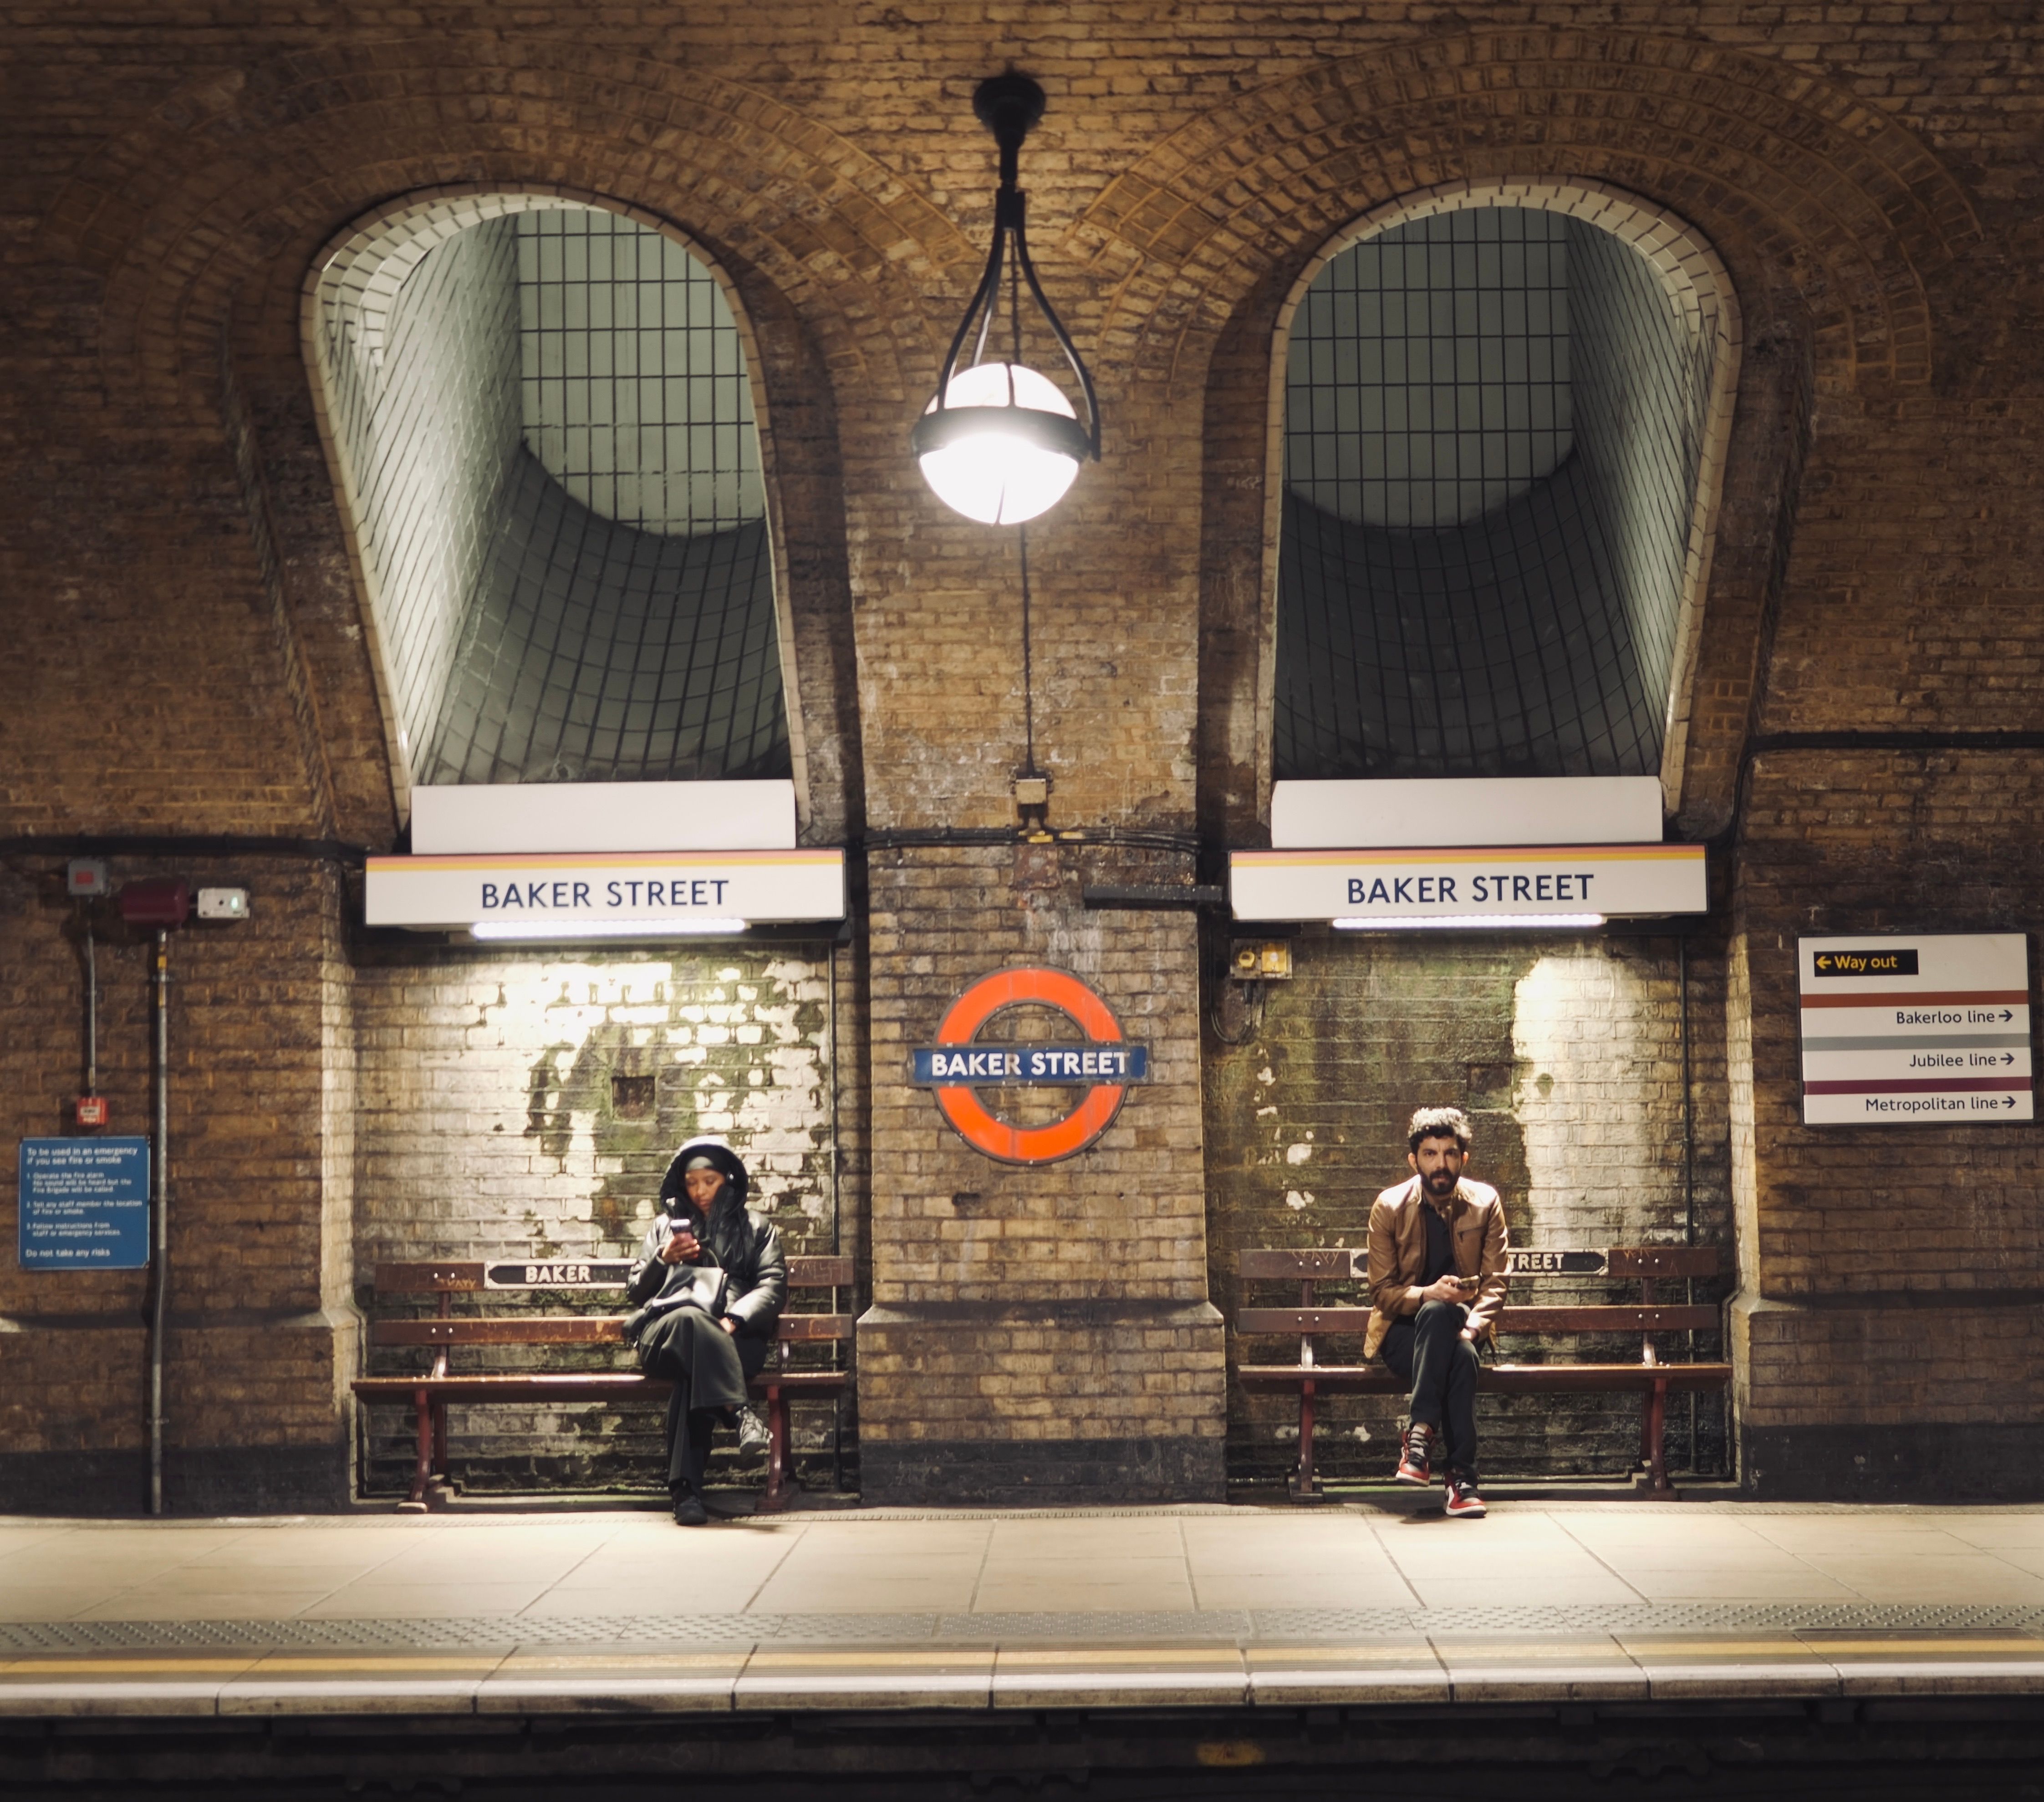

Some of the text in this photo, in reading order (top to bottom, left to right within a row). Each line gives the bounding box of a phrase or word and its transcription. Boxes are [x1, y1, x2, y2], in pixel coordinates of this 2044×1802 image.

[482, 880, 729, 909] BAKER STREET
[1347, 874, 1595, 904] BAKER STREET
[1834, 956, 1898, 971] Way out
[1896, 1010, 1995, 1024] Bakerloo line
[931, 1052, 1130, 1076] BAKER STREET
[1909, 1054, 1997, 1067] Jubilee line
[1866, 1097, 1998, 1114] Metropolitan line
[27, 1147, 37, 1156] To
[51, 1147, 71, 1156] used
[73, 1147, 81, 1156] in
[94, 1147, 138, 1156] emergency
[35, 1157, 50, 1166] you
[52, 1157, 66, 1165] see
[68, 1156, 83, 1165] fire
[84, 1156, 93, 1165] or
[95, 1156, 122, 1165] smoke
[25, 1248, 37, 1257] Do
[56, 1248, 73, 1257] take
[75, 1249, 89, 1258] any
[91, 1248, 110, 1257] risks
[525, 1266, 591, 1283] BAKER
